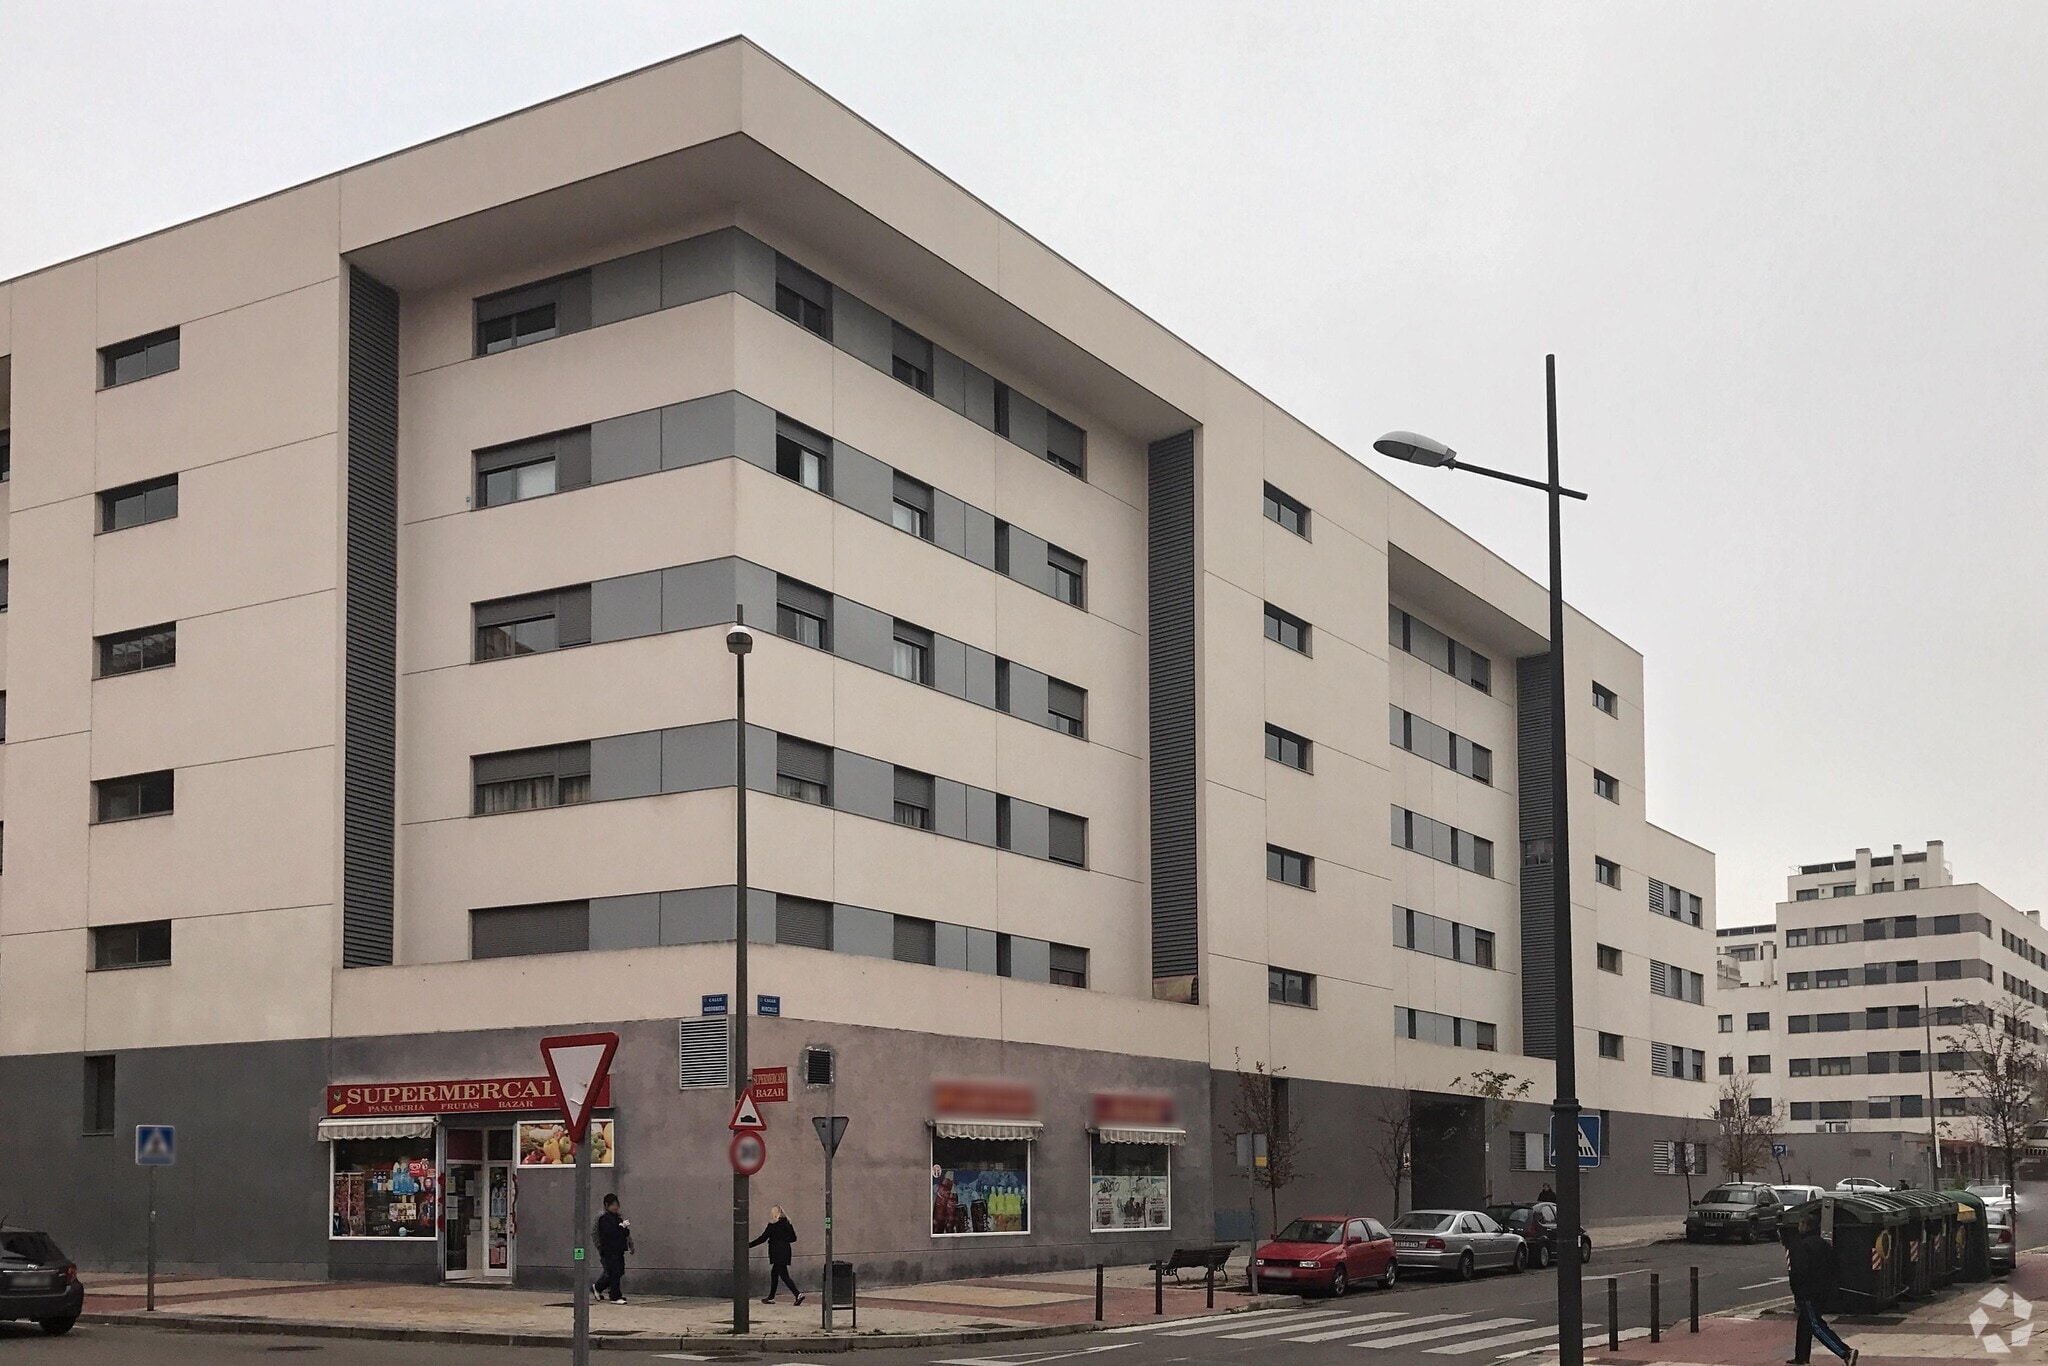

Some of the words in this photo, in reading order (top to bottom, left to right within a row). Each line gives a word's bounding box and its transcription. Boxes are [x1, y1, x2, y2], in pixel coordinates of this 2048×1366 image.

[756, 1087, 784, 1098] BAZAR
[368, 1103, 425, 1113] PANADERIA
[440, 1101, 480, 1110] FRUTAS
[498, 1100, 534, 1108] BAZAR
